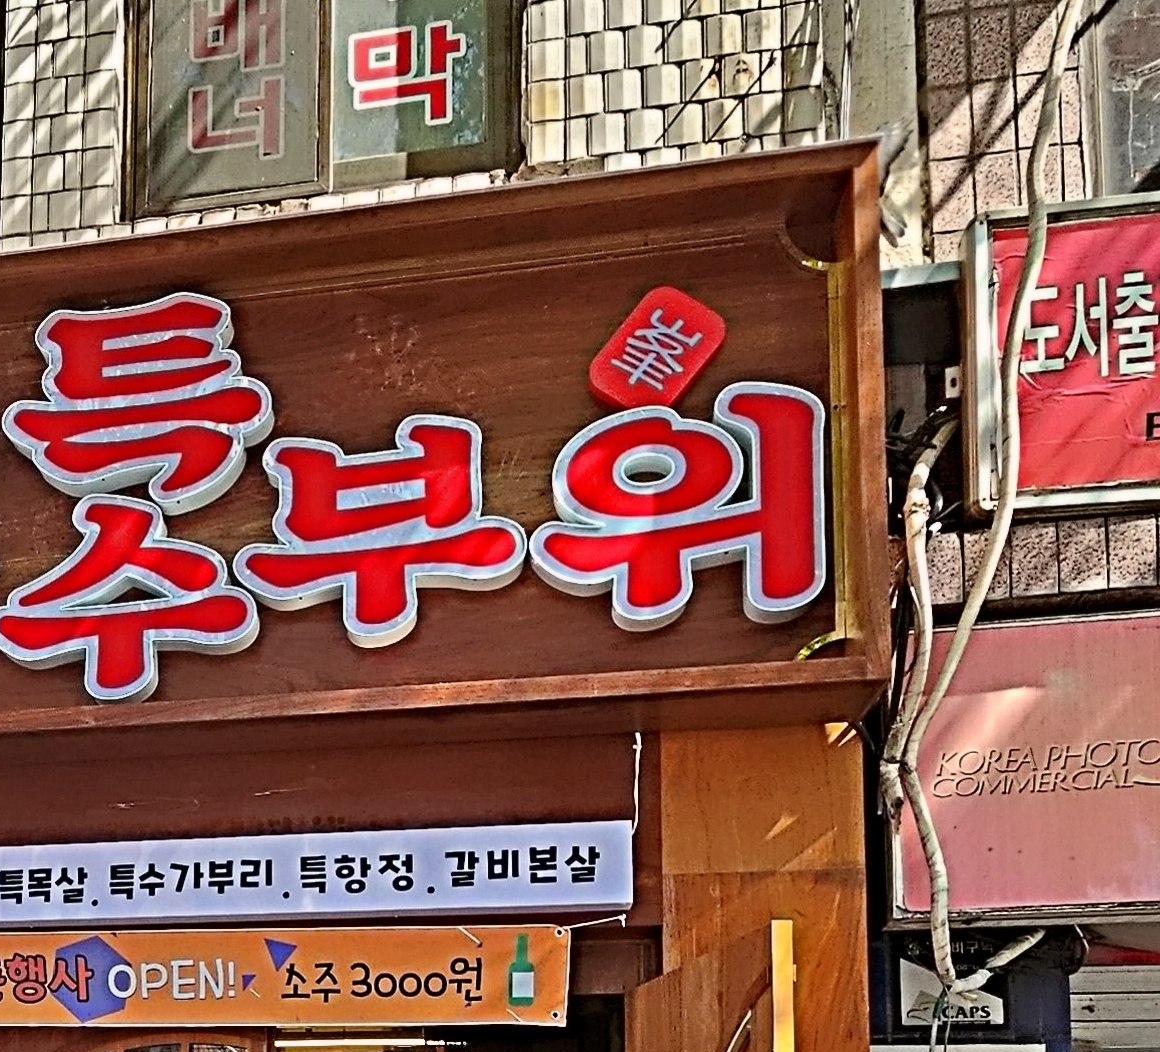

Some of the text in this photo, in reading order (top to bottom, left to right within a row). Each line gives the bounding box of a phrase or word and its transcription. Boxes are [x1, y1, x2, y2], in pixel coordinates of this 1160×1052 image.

[348, 20, 467, 126] 막
[936, 738, 1160, 777] KOREA PHOTO
[930, 767, 1134, 799] COMMERCIAL
[444, 845, 601, 887] 갈비본살
[106, 957, 236, 1000] OPEN!
[281, 963, 340, 1003] 소주
[350, 956, 484, 1003] 3000원
[941, 1005, 991, 1019] CAPS
